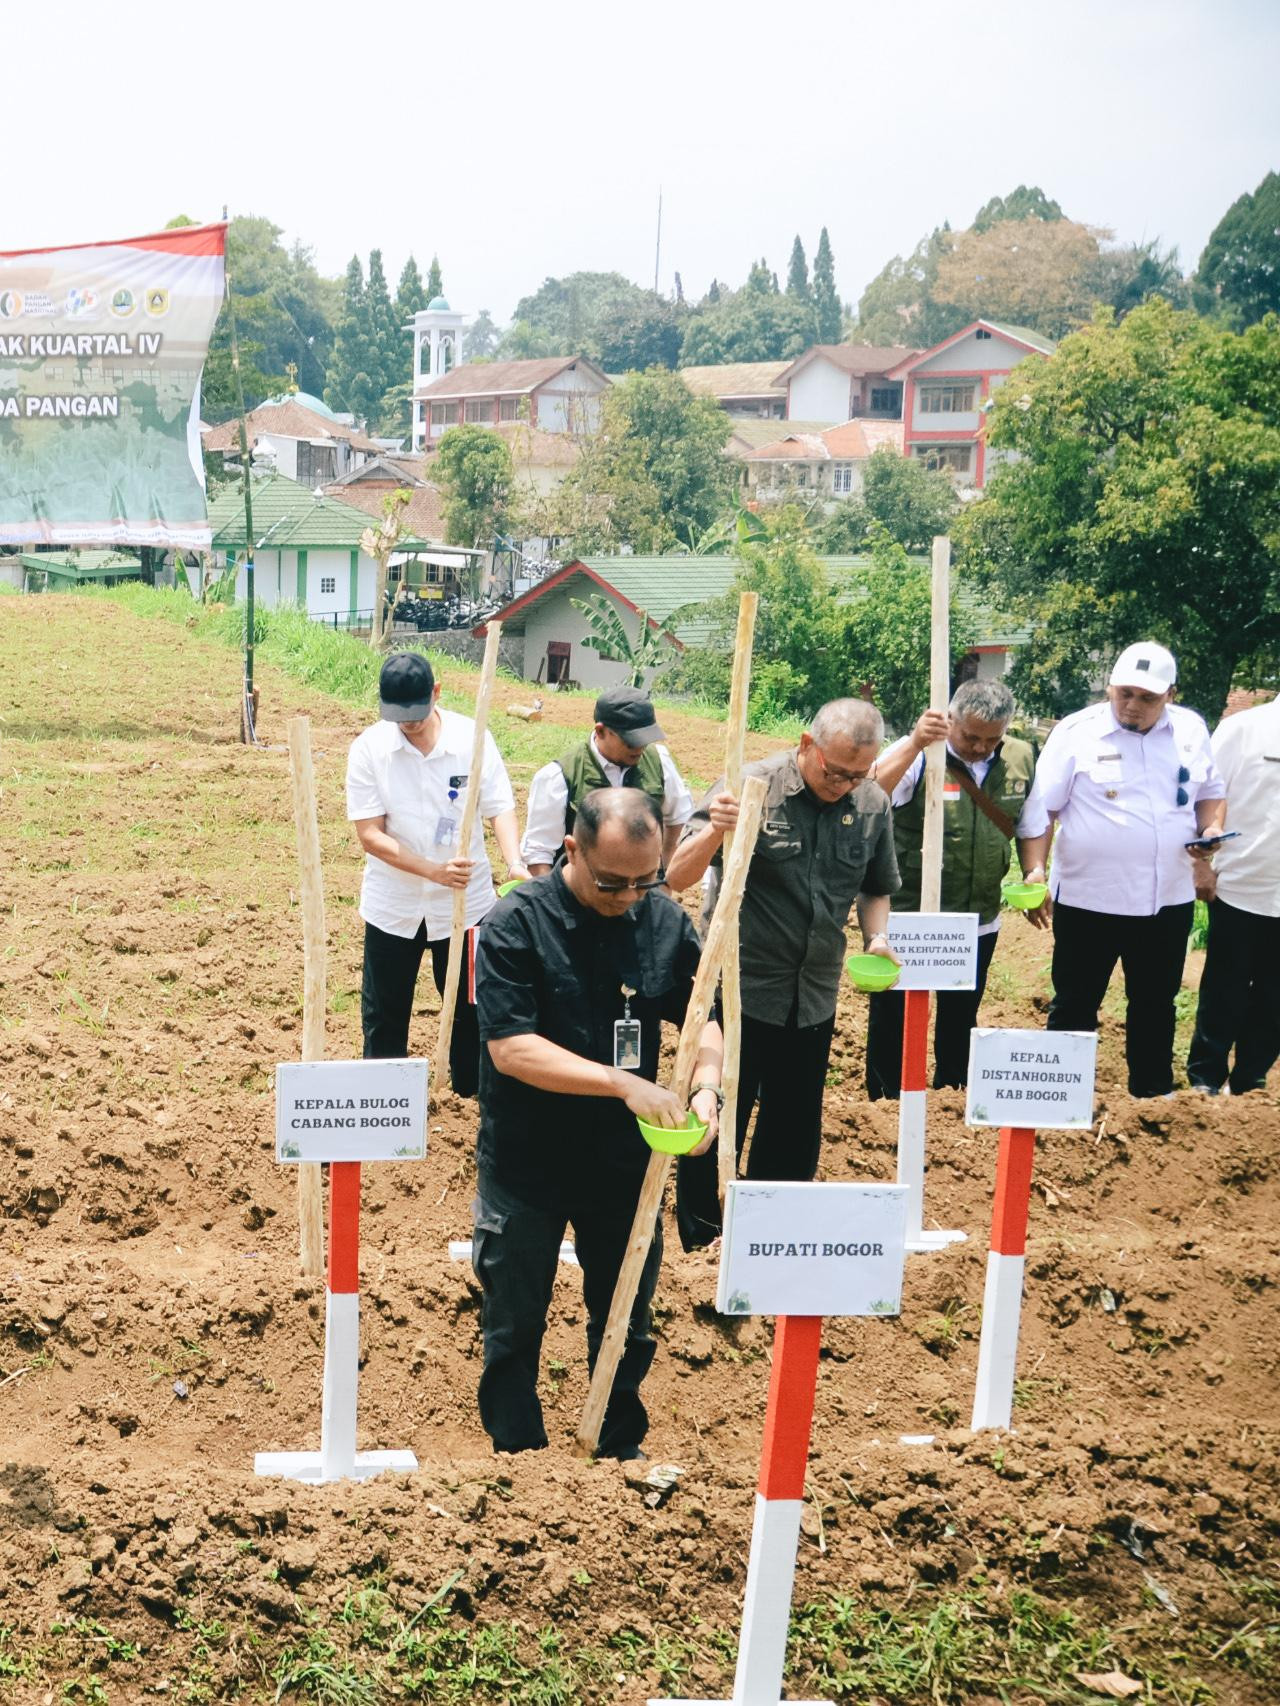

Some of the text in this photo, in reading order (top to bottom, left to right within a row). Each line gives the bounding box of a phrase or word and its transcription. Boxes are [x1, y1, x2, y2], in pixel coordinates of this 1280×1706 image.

[30, 334, 133, 356] KUARTAL
[138, 334, 161, 355] IV
[26, 396, 118, 416] PANGAN
[888, 933, 966, 941] EPALA CABANG
[908, 946, 971, 954] KEHUTANAN
[933, 959, 966, 967] BOGOR
[1010, 1052, 1060, 1064] KEPALA
[981, 1069, 1082, 1084] DISTANHORBUN
[995, 1088, 1068, 1102] KAB BOGOR
[294, 1098, 410, 1110] KEPALA BULOG
[291, 1117, 411, 1129] CABANG BOGOR
[748, 1243, 885, 1257] BUPATI BOGOR
